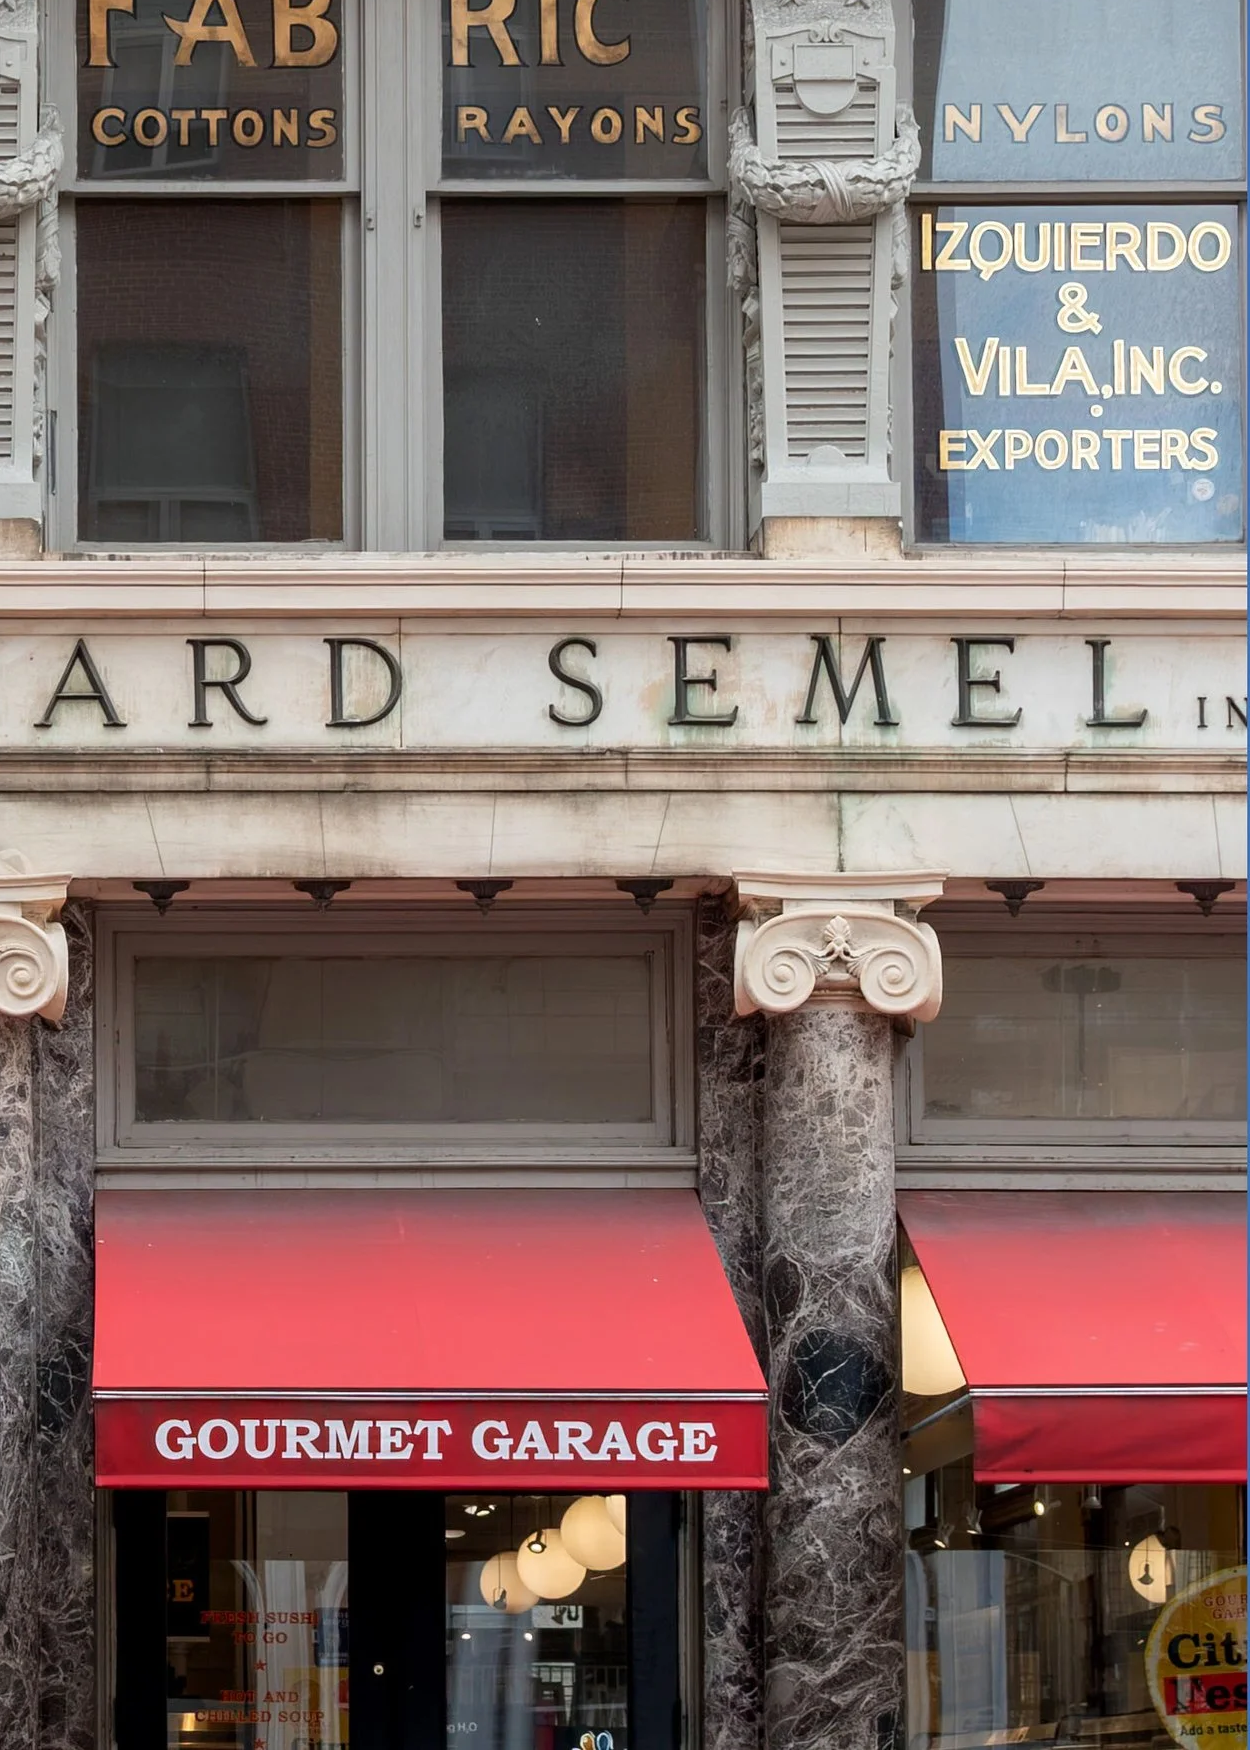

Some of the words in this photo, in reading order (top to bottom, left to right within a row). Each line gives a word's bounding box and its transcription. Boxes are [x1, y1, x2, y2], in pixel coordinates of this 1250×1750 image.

[91, 106, 338, 148] COTTONS
[456, 105, 703, 146] RAYONS
[942, 102, 1228, 144] NYLONS
[920, 213, 1231, 281] IZQUIERDO
[1056, 281, 1103, 335] &
[939, 428, 1219, 471] EXPORTERS
[548, 635, 1148, 727] SEMEL
[154, 1418, 452, 1461] GOURMET
[471, 1420, 717, 1462] GARAGE
[199, 1610, 260, 1624] FRESH
[266, 1611, 318, 1625] SUSHI
[234, 1632, 255, 1644] TO
[263, 1632, 288, 1644] GO
[1168, 1632, 1247, 1669] Cit
[195, 1710, 271, 1723] CHILLED
[279, 1710, 325, 1723] SOUP
[220, 1690, 255, 1703] HOT
[263, 1690, 299, 1703] AND
